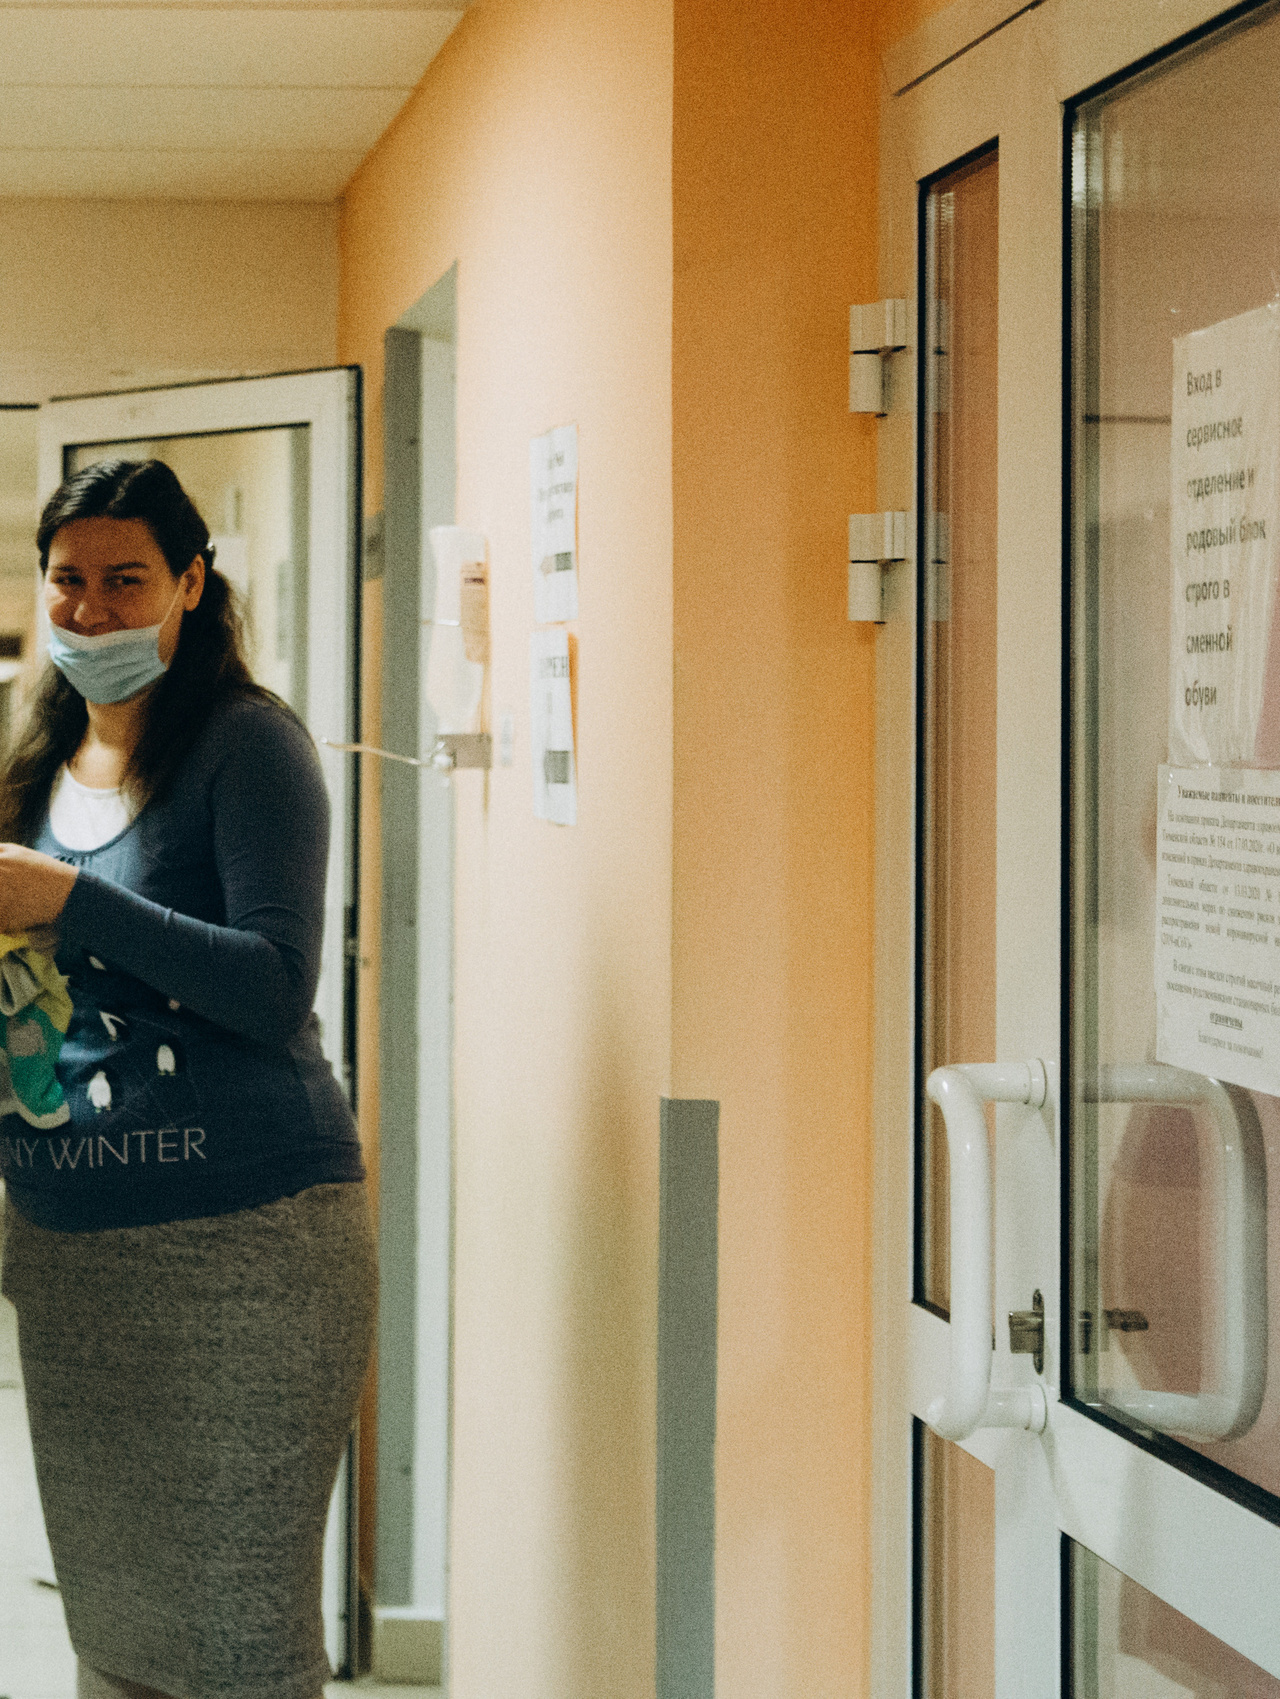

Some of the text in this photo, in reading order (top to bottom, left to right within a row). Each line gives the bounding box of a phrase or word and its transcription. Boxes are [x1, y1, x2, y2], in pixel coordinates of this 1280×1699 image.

[1186, 368, 1222, 397] Вход в
[1186, 416, 1243, 452] сервисное
[1186, 469, 1245, 503] отделение
[1185, 515, 1267, 557] родовый блок
[1185, 578, 1230, 608] строго в
[1186, 623, 1233, 654] сменной
[1184, 678, 1217, 713] обуви
[47, 1127, 207, 1170] WINTER
